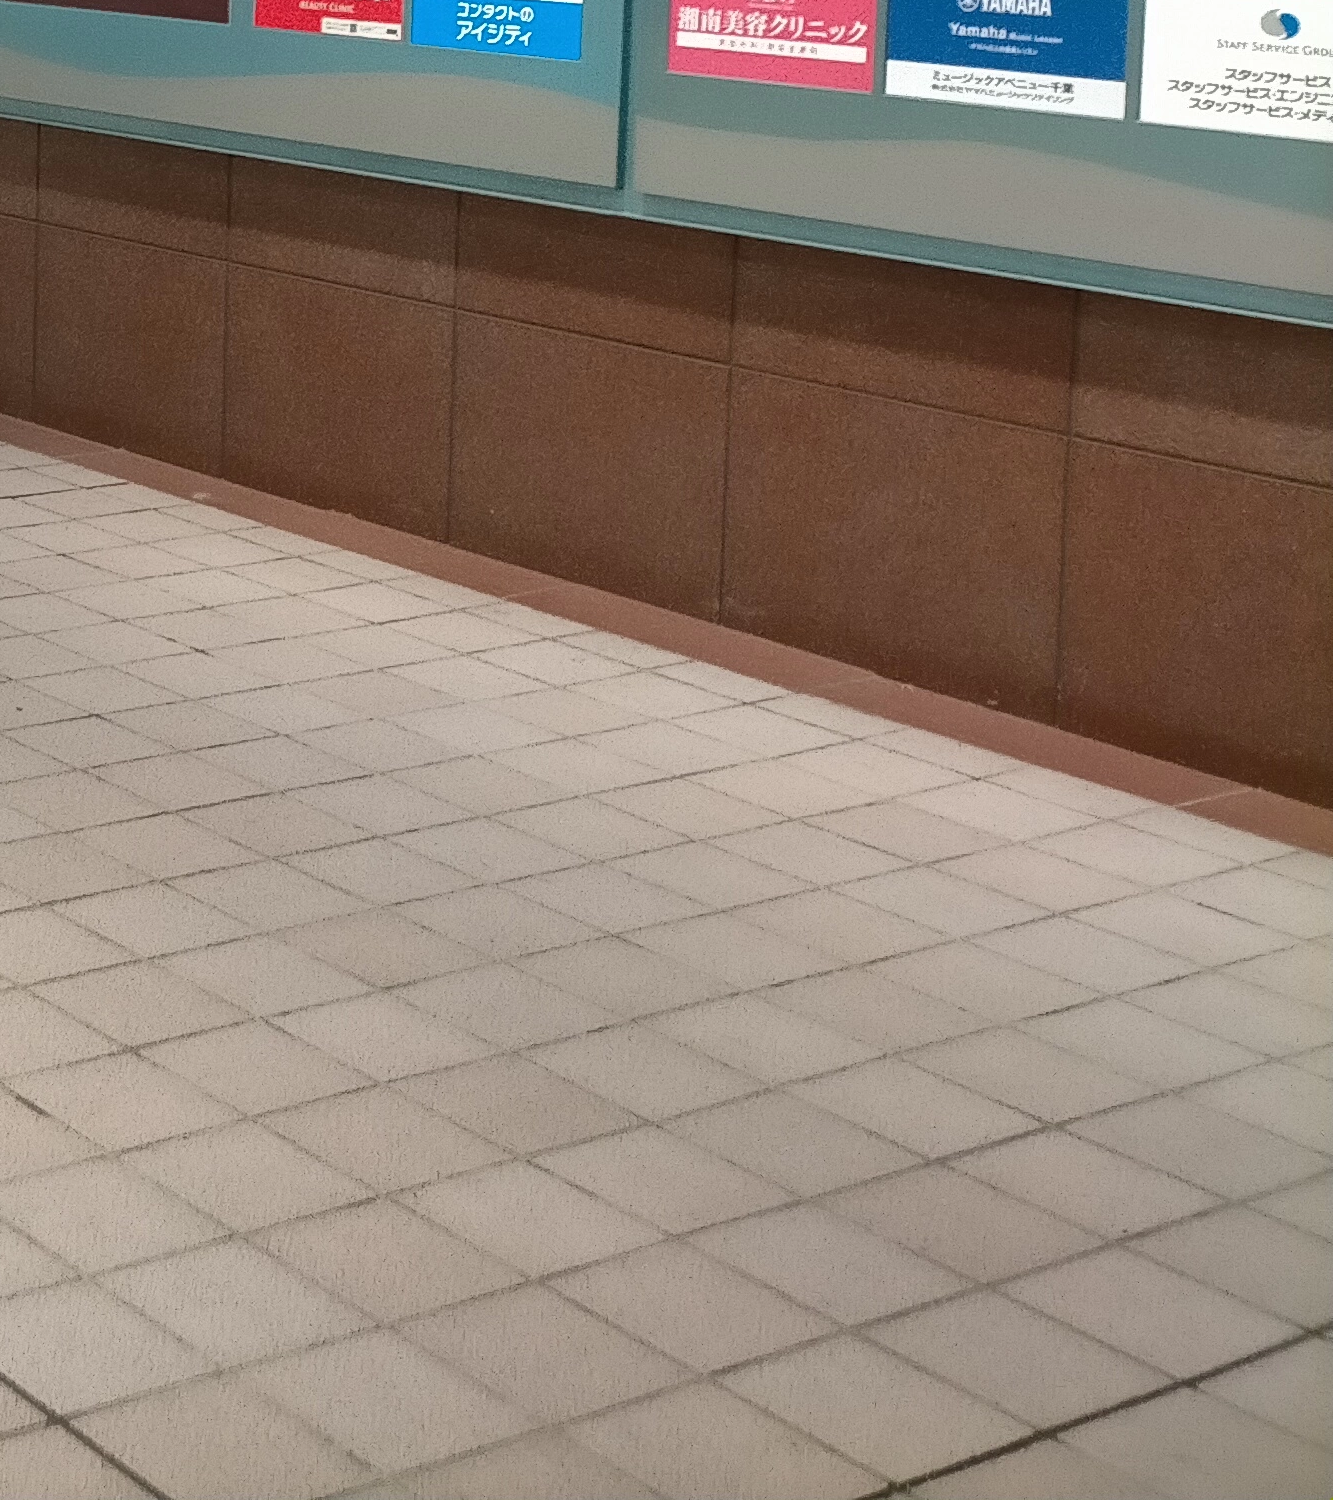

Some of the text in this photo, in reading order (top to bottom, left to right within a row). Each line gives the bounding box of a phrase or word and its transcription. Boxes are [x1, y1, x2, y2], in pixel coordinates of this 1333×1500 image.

[456, 2, 534, 22] コンタクトの
[456, 20, 532, 46] アイシティ
[677, 5, 868, 44] 湘南美容クリニック
[948, 21, 1007, 40] Yamaha
[933, 70, 1074, 95] ミュージックアベニュー千葉
[1225, 67, 1331, 88] スタッフサービス
